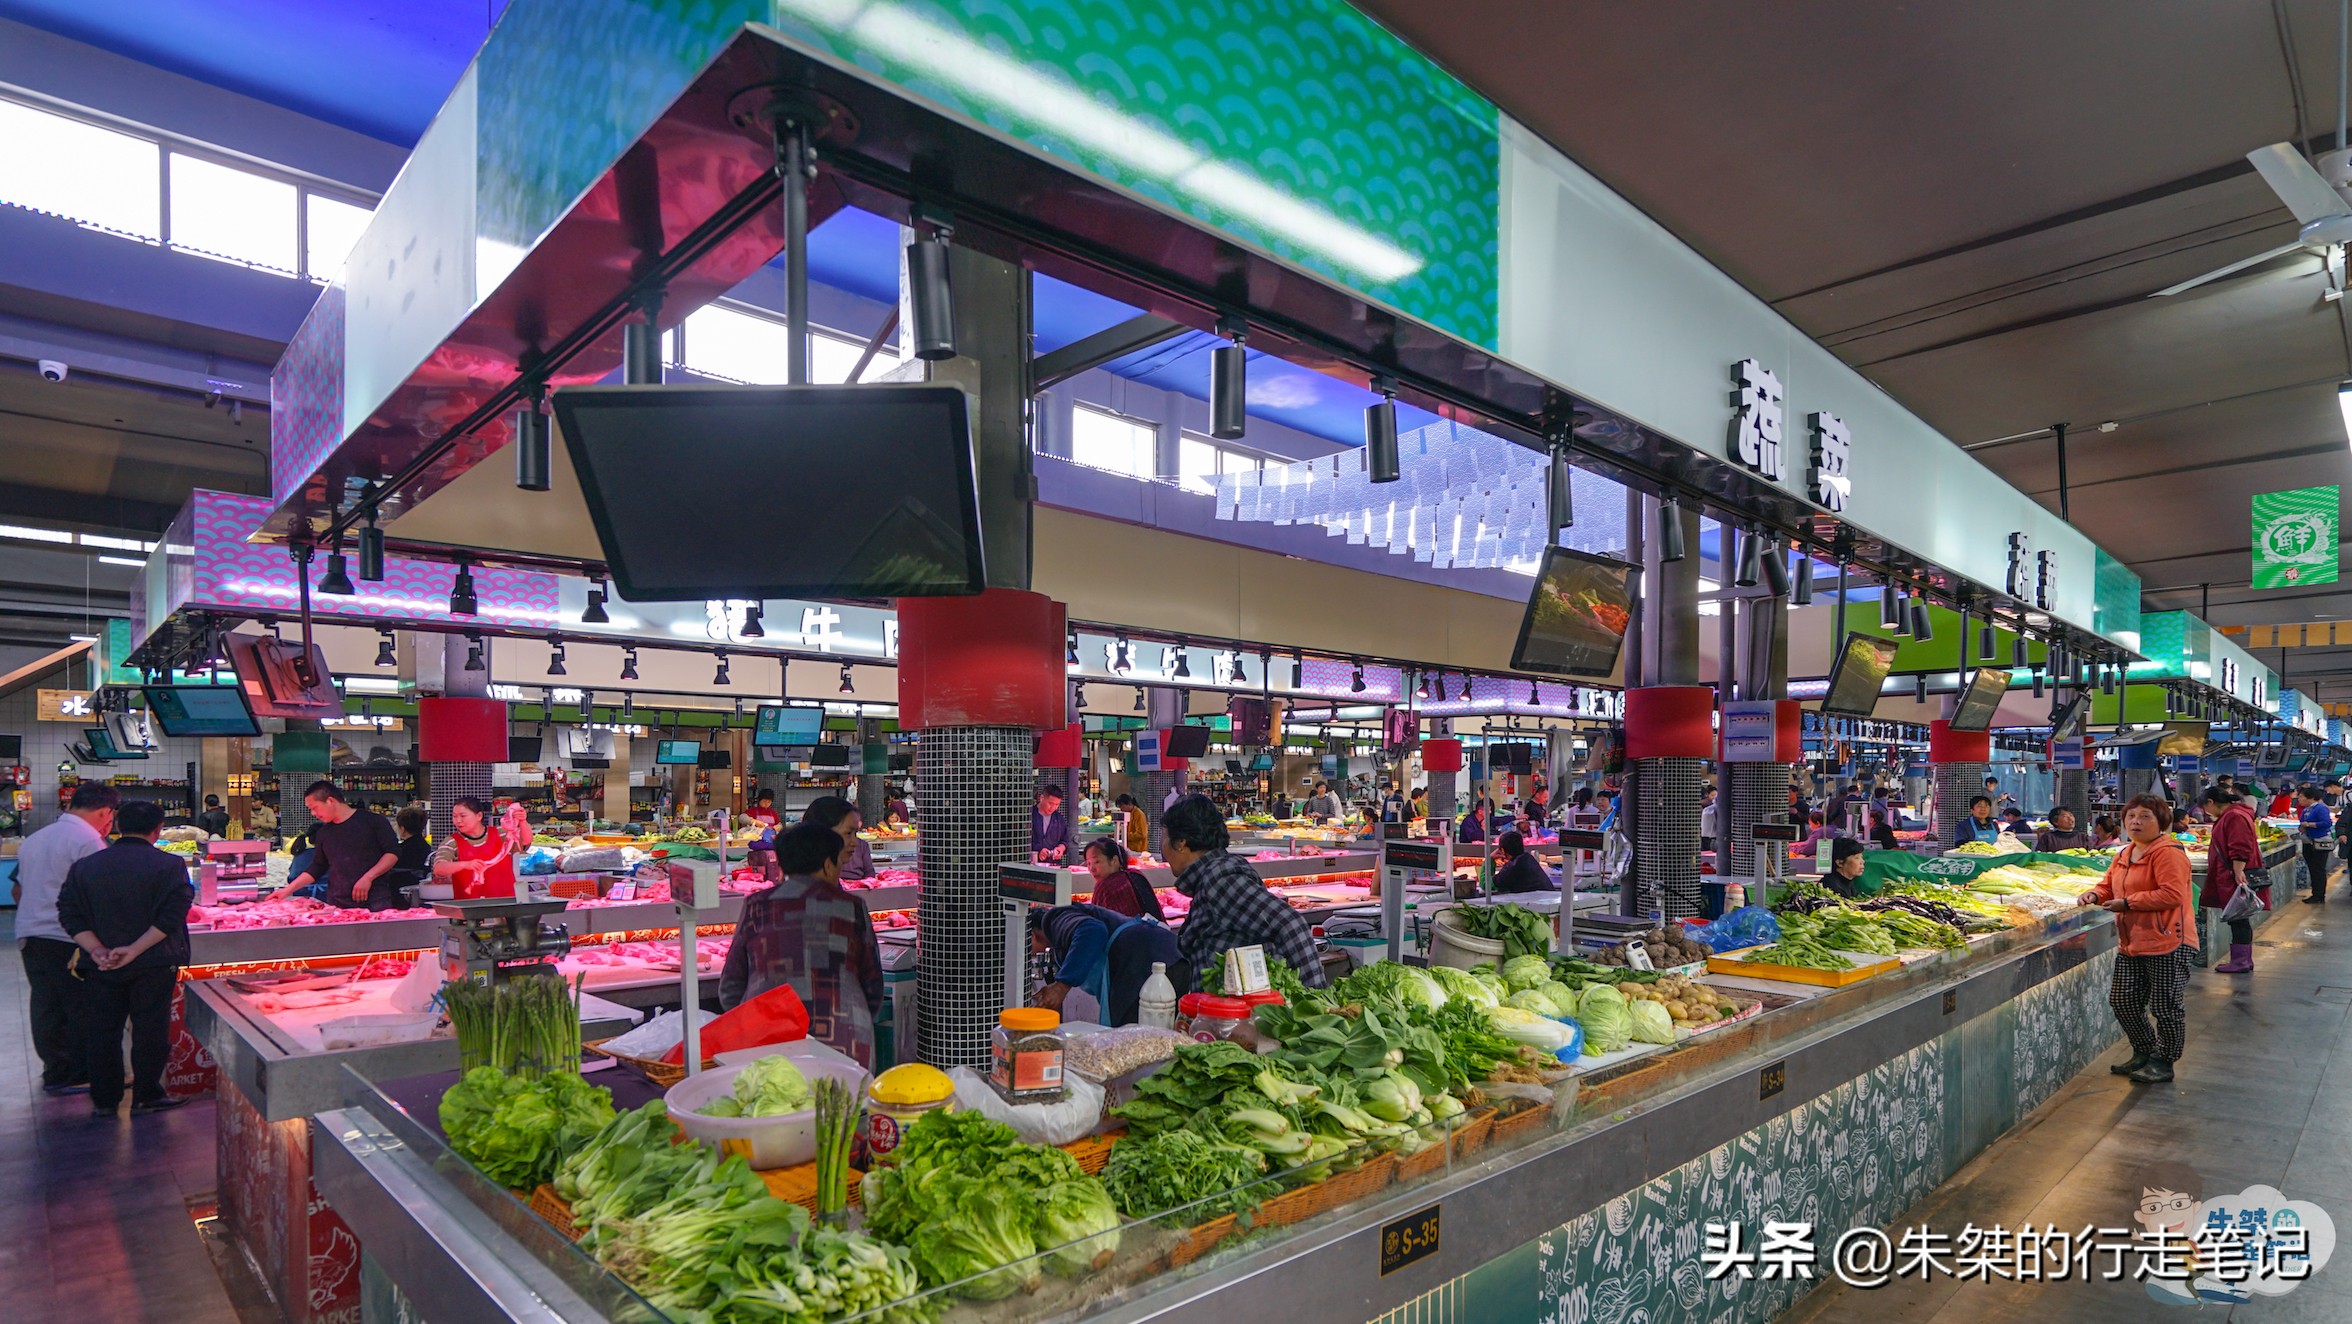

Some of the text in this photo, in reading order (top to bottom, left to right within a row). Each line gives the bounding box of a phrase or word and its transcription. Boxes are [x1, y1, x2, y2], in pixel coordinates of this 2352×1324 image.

[1727, 358, 1851, 511] 蔬菜
[167, 1072, 205, 1087] ARKET
[1644, 1186, 1668, 1207] Market
[1402, 1217, 1438, 1255] S-35
[1675, 1217, 1699, 1264] FOODS
